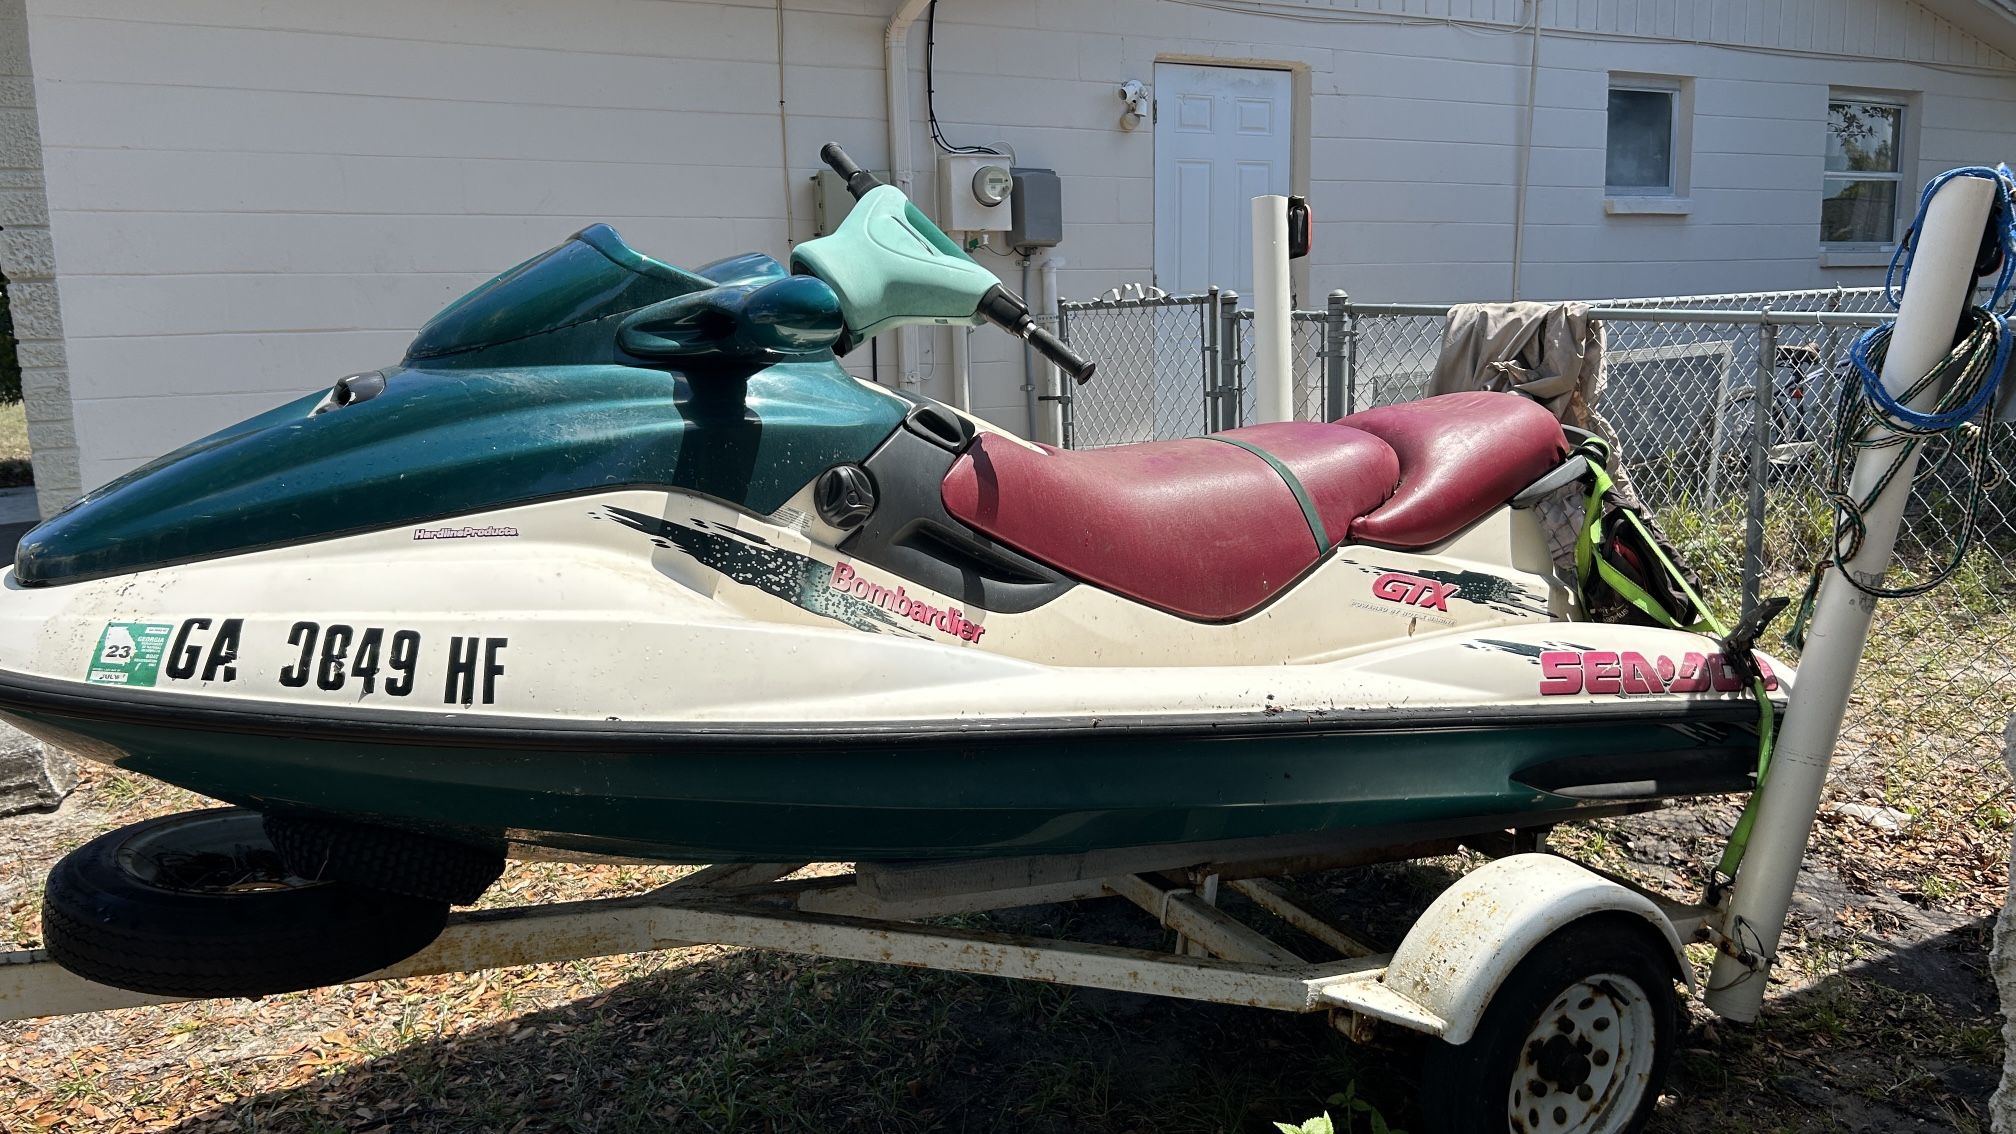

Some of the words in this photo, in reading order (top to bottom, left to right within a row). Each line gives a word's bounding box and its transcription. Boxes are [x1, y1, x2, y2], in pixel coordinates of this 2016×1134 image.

[829, 561, 986, 644] Bombardier
[1372, 572, 1460, 612] GTX
[105, 645, 132, 658] 23
[166, 618, 244, 682] GA
[279, 621, 421, 696] 3849
[444, 637, 508, 704] HF
